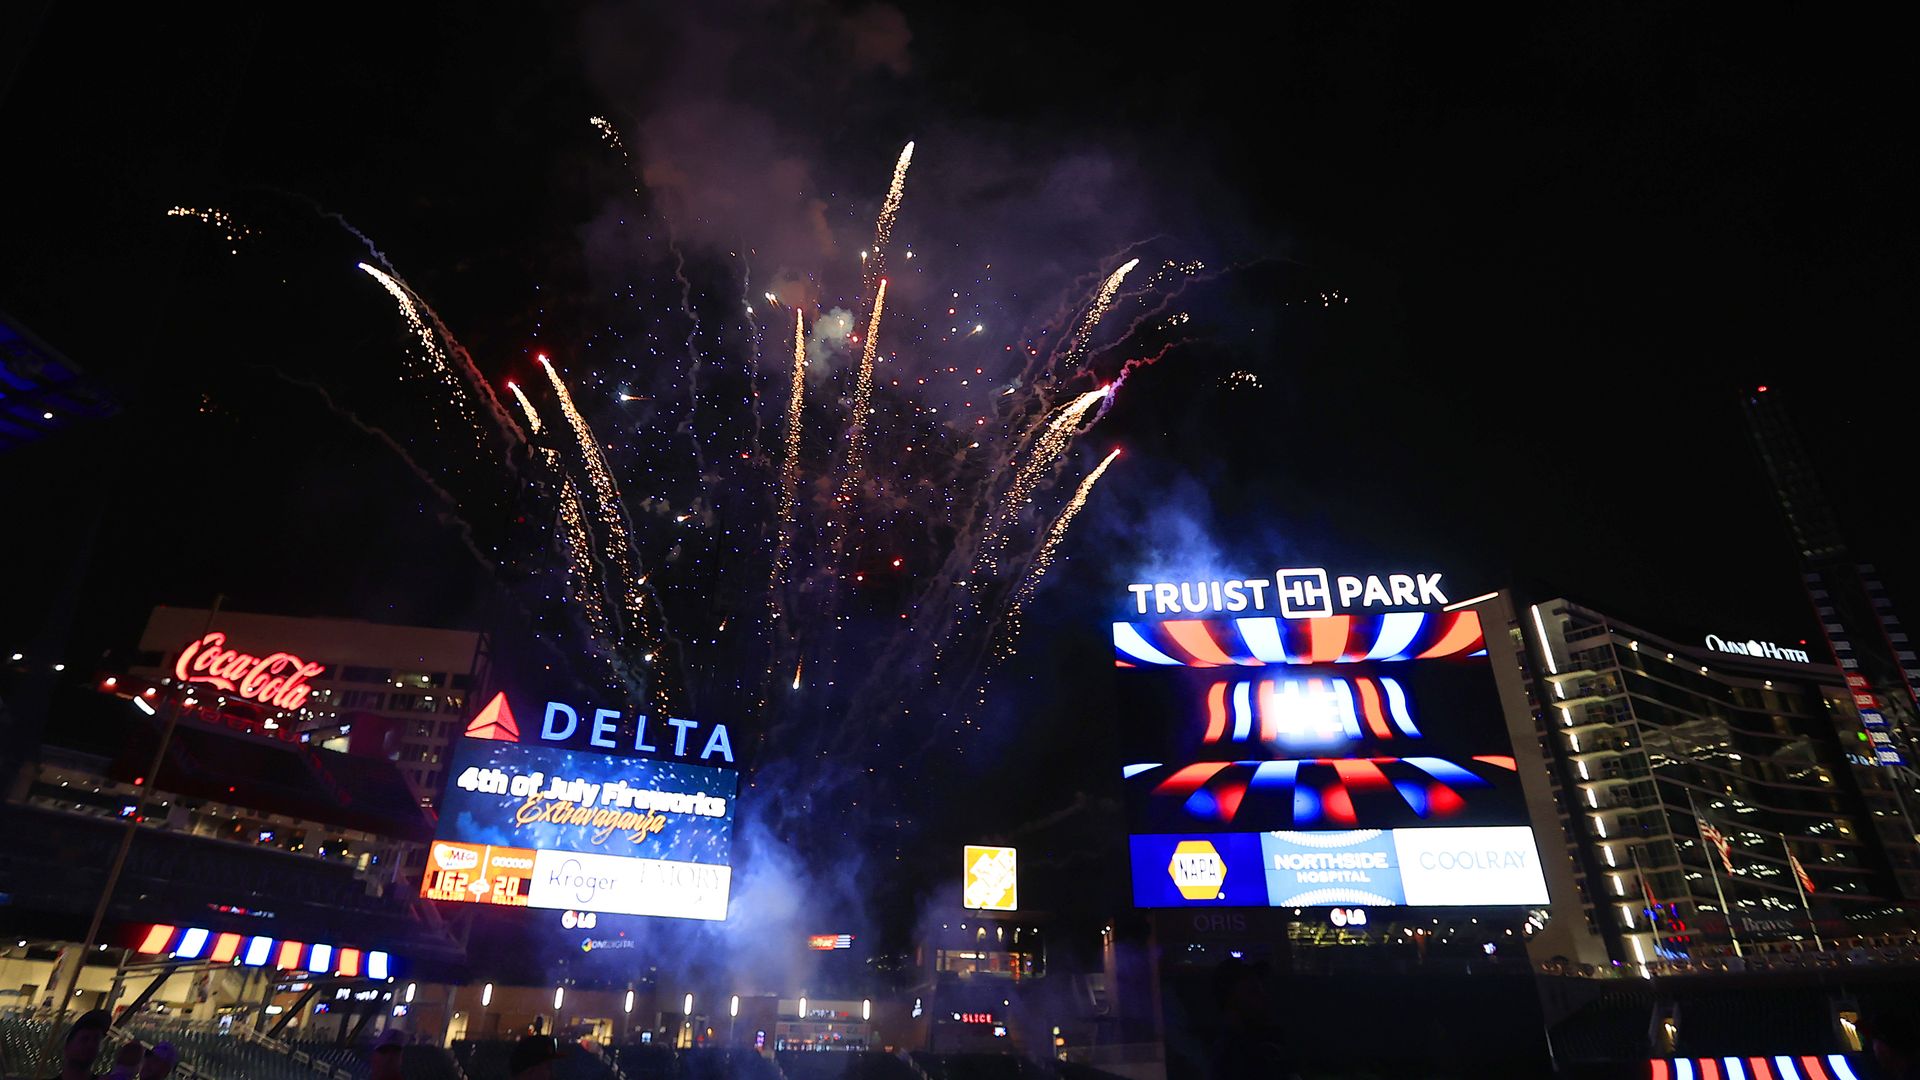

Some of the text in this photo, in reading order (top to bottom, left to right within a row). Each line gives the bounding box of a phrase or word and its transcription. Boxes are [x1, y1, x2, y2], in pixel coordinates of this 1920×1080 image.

[1128, 573, 1448, 614] TRUIST PARK
[175, 631, 326, 711] Coca-Cola
[540, 701, 735, 763] DELTA
[456, 766, 727, 818] 4th of July Fireworks
[515, 792, 668, 845] Extravaganza
[1179, 858, 1218, 881] NAPA
[1273, 852, 1390, 870] NORTHSIDE
[1418, 850, 1527, 870] COOLRAY
[434, 870, 469, 892] 162
[493, 876, 521, 896] 20
[548, 858, 618, 903] Kroger
[1296, 871, 1371, 883] HOSPITAL
[1193, 912, 1248, 933] ORIS
[962, 1013, 993, 1024] SLICE
